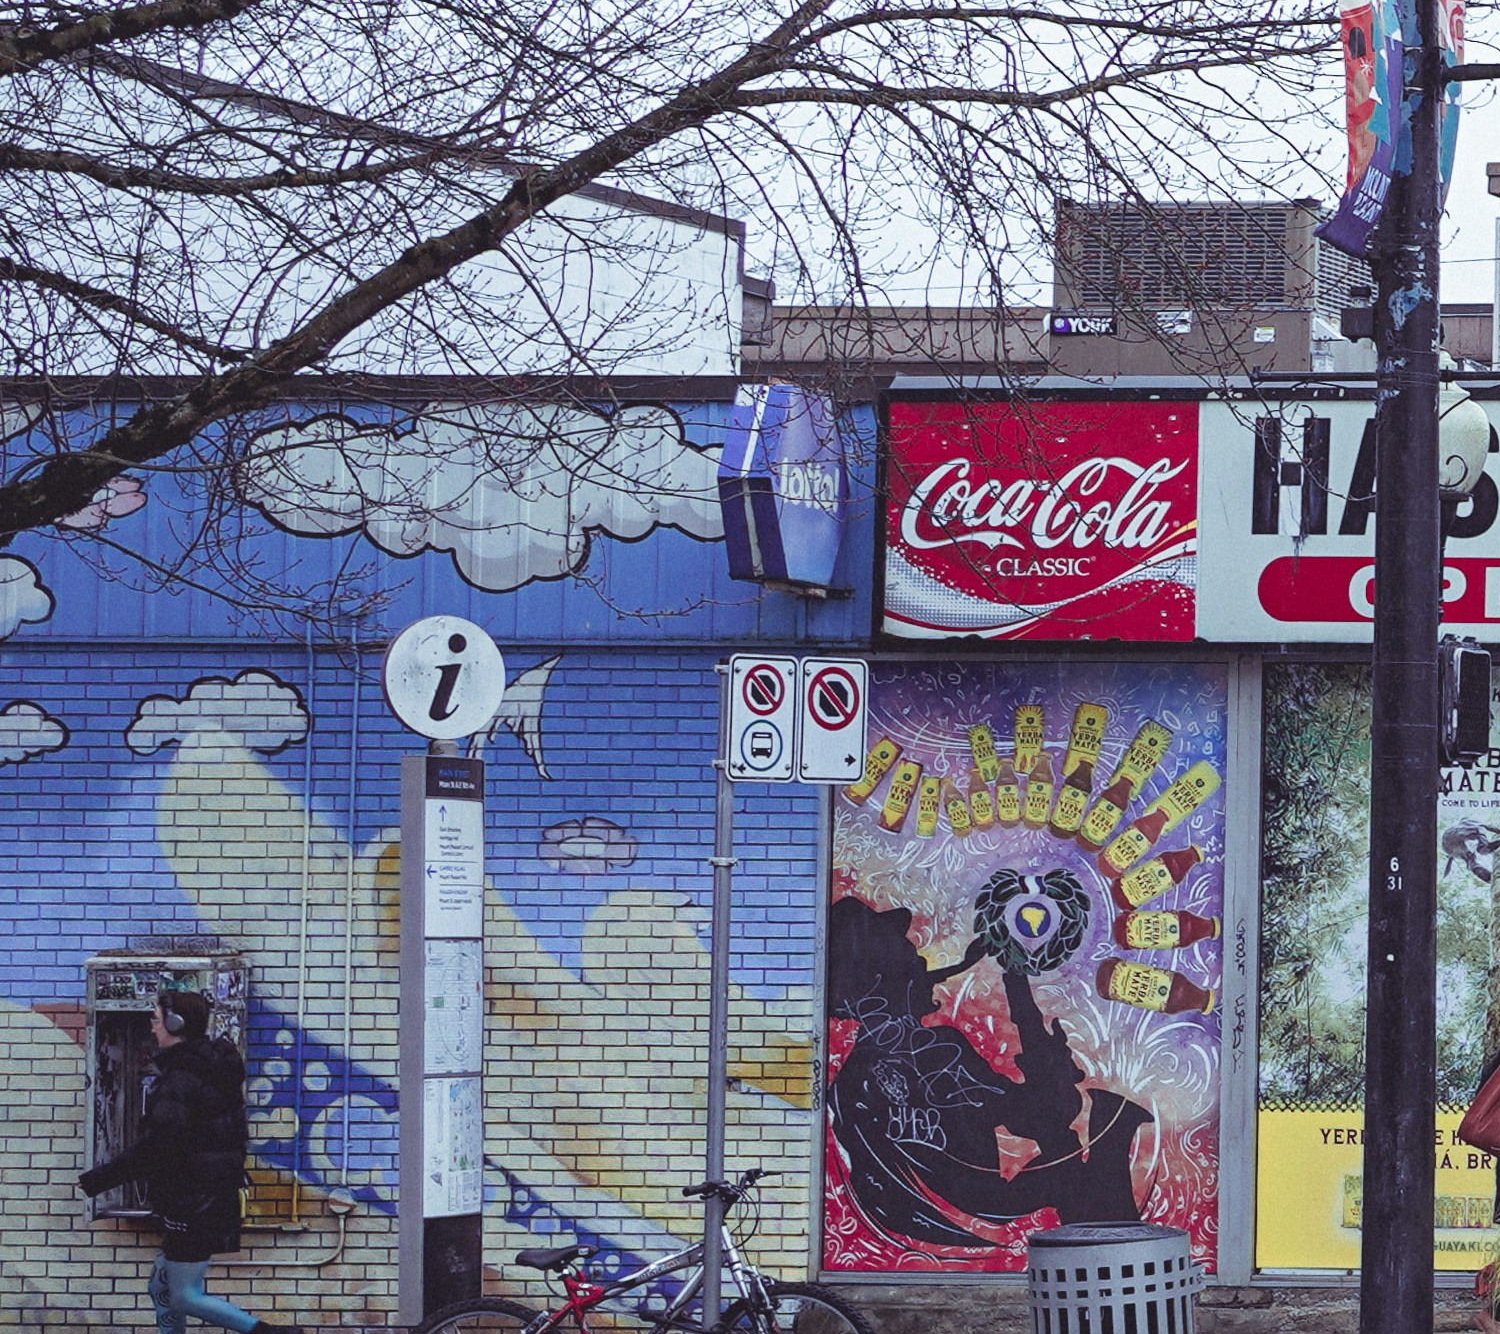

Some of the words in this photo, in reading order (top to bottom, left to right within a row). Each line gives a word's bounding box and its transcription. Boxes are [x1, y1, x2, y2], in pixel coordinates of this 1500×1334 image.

[1069, 317, 1114, 333] YORK
[900, 457, 1190, 551] Coca-Cola
[996, 557, 1091, 577] CLASSIC
[1072, 731, 1102, 745] YERBA
[1074, 740, 1097, 752] MATE
[1129, 756, 1151, 773] MATE
[1130, 746, 1158, 770] YERBA
[1441, 799, 1466, 808] COME
[1468, 800, 1480, 808] TO
[1390, 856, 1400, 873] 6
[1387, 875, 1403, 891] 31
[1143, 917, 1151, 943] MATE
[1150, 914, 1160, 947] YERBA
[1126, 970, 1140, 997] MATE
[1135, 968, 1151, 1005] YERBA
[1320, 1128, 1365, 1145] YER
